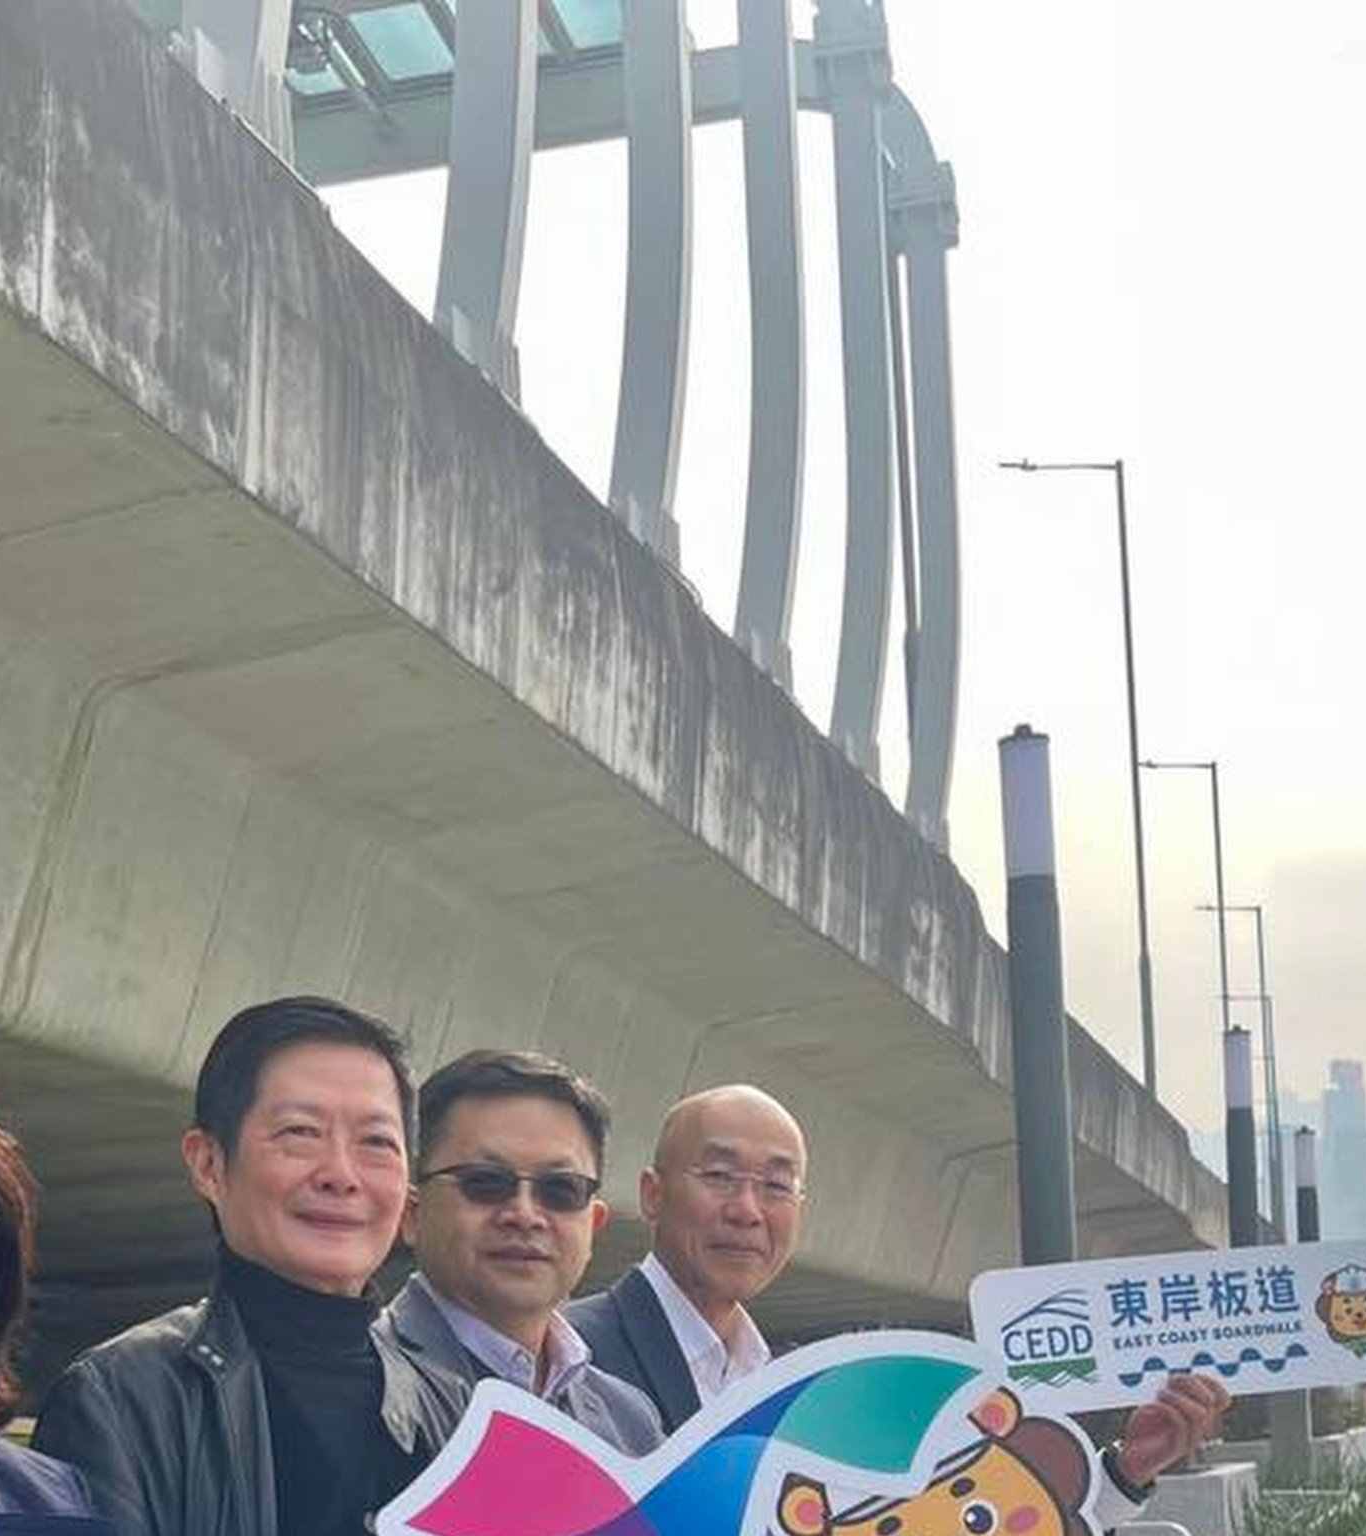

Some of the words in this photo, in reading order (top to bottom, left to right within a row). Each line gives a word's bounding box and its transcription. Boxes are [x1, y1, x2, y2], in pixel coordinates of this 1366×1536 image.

[1105, 1264, 1301, 1328] 東岸板道
[1002, 1324, 1094, 1362] CEDD
[1113, 1334, 1155, 1351] EAST
[1157, 1328, 1209, 1346] COAST
[1212, 1319, 1303, 1341] BOARDWALK
